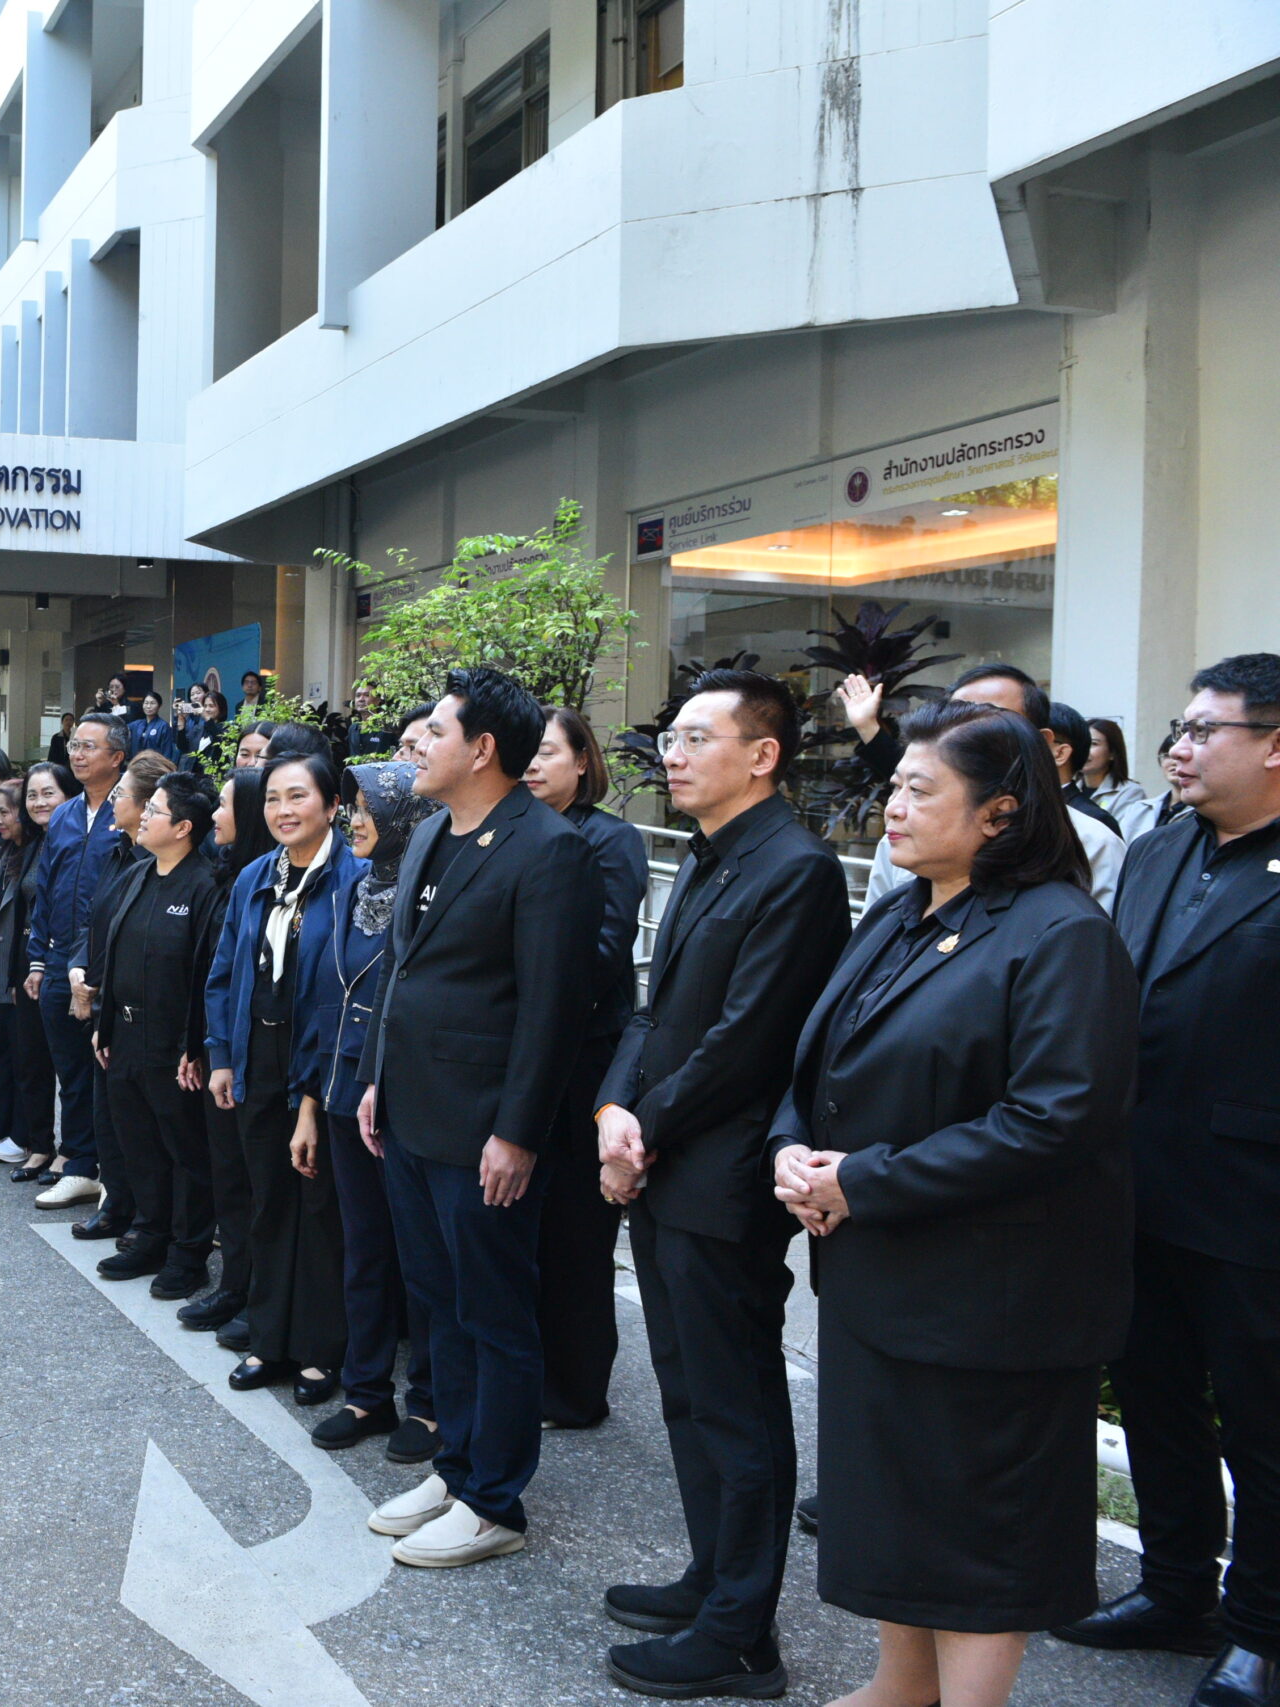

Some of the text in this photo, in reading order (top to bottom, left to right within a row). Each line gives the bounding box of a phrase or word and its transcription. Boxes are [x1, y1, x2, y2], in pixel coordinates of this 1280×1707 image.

[882, 428, 1046, 481] สำนักงานปลัดกระทรวง
[668, 496, 752, 535] ศูนย์บริการร่วม
[668, 533, 718, 552] Service Link
